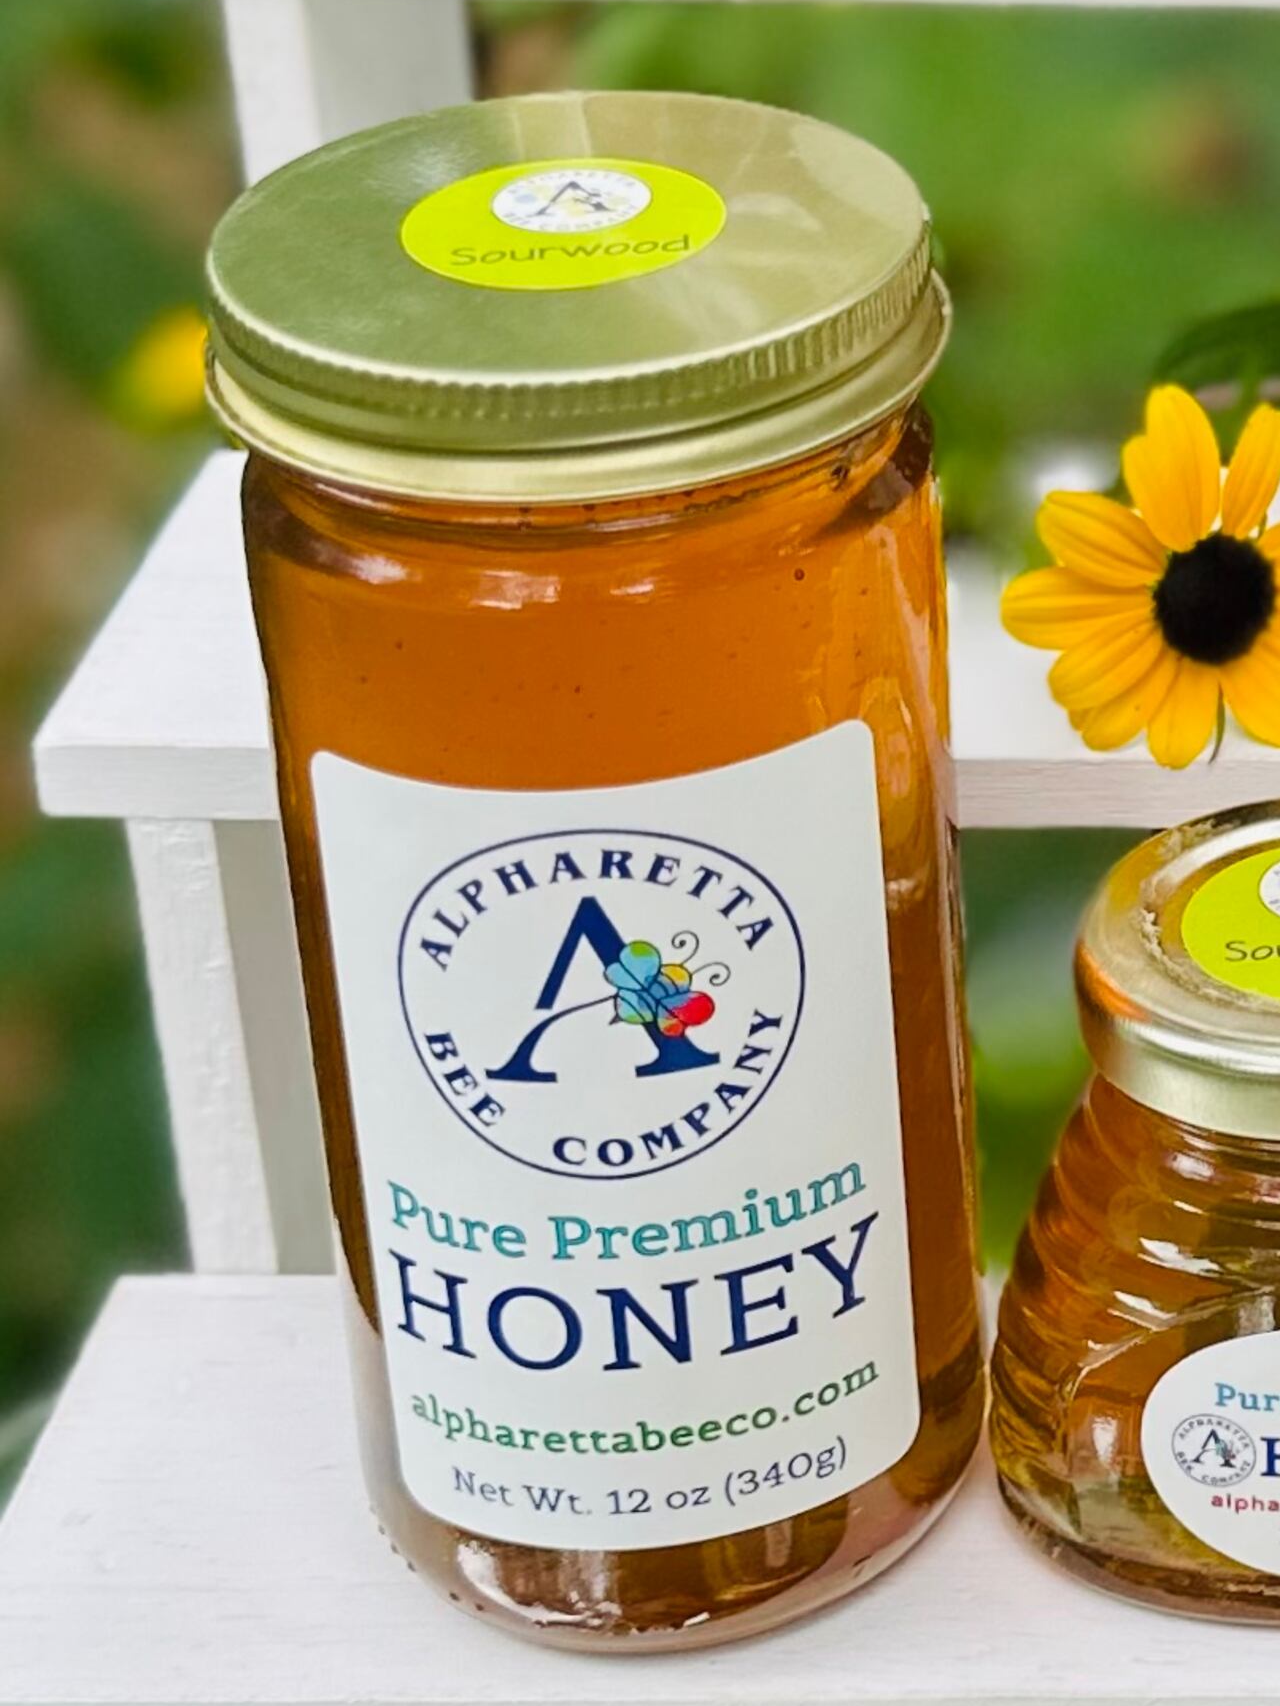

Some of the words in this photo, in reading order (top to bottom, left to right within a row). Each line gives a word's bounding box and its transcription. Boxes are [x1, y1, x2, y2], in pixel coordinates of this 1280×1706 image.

[450, 234, 690, 265] Sourwood
[420, 849, 774, 972] ALPHARETTA
[424, 1031, 506, 1127] BEE
[552, 1009, 783, 1167] COMPANY
[387, 1180, 527, 1258] Pure
[549, 1162, 866, 1260] Premium
[389, 1211, 879, 1371] HONEY
[411, 1359, 879, 1455] alpharettabeeco.com
[452, 1467, 511, 1507] Net
[523, 1485, 593, 1516] Wt.
[607, 1490, 651, 1515] 12
[666, 1485, 711, 1510] oz
[724, 1435, 846, 1507] (340g)
